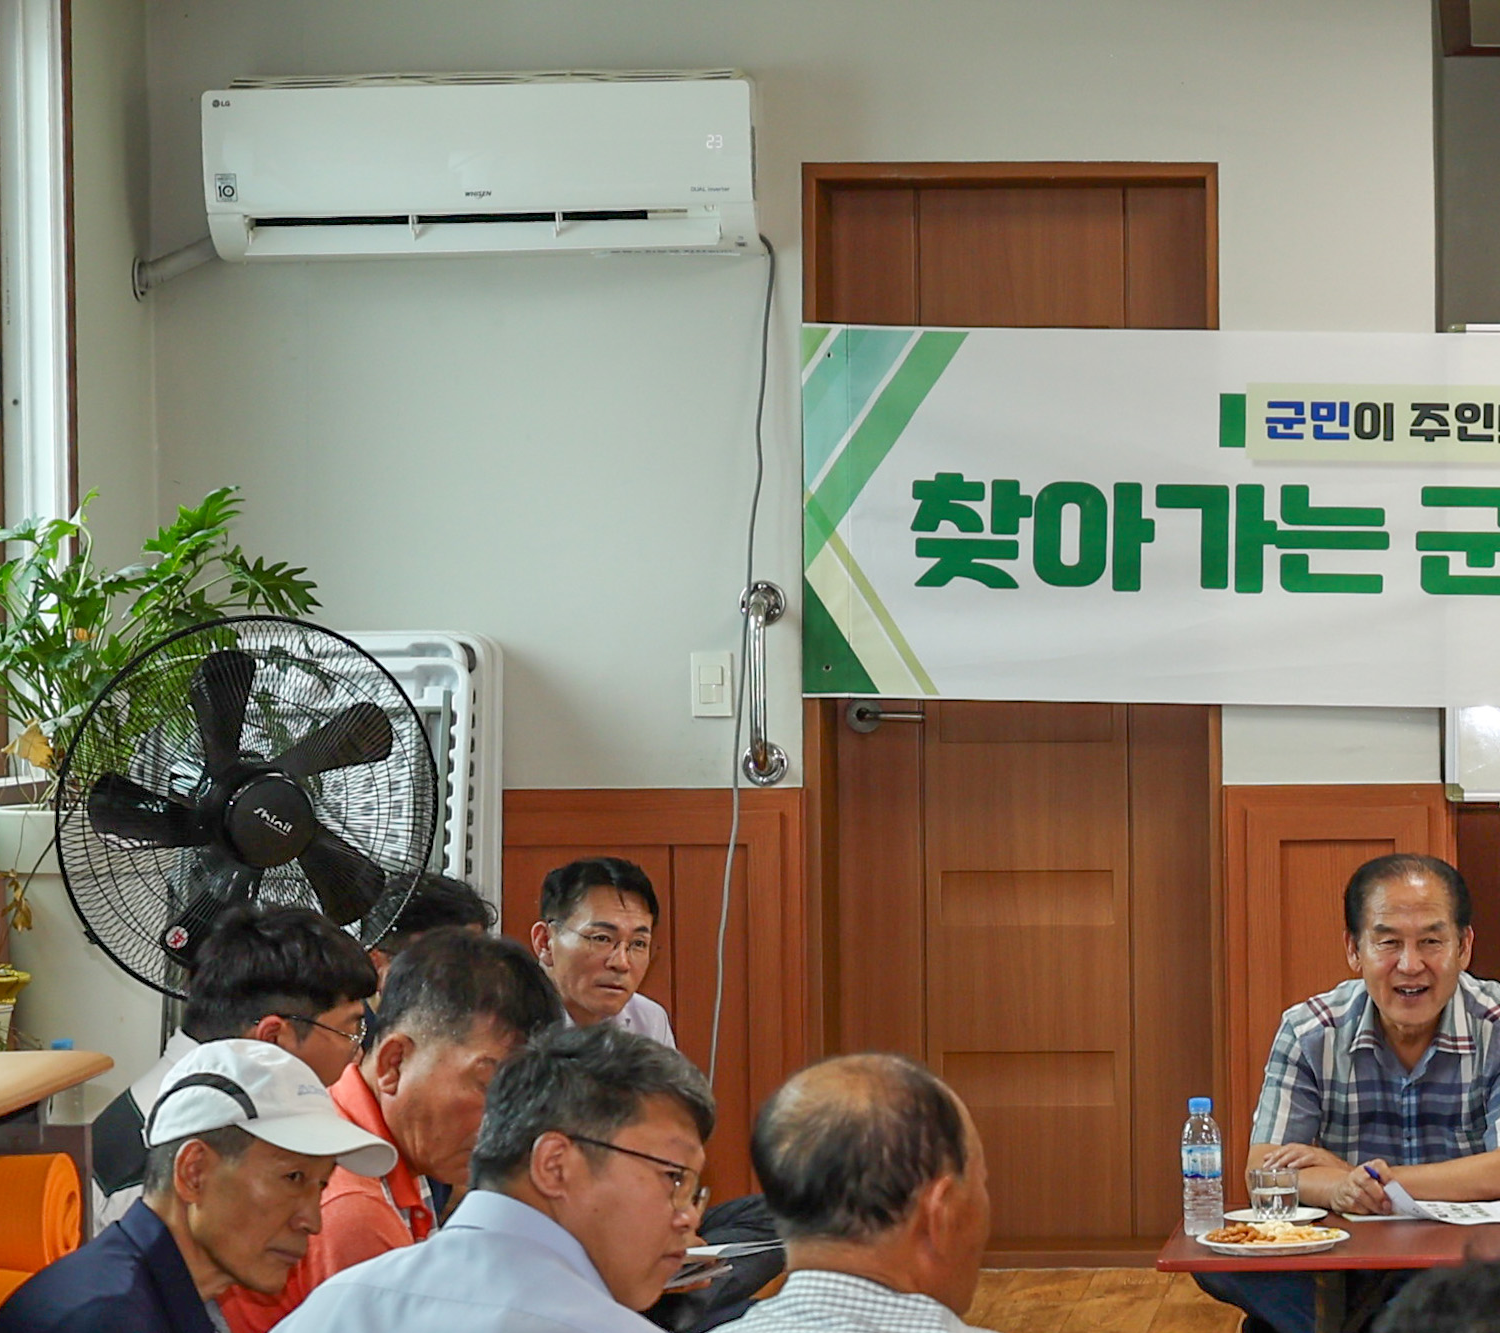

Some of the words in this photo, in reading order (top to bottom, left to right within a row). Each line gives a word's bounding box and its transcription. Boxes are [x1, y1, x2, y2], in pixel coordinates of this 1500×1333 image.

[706, 134, 724, 149] 23
[1265, 400, 1394, 442] 군민이
[910, 472, 1390, 594] 찾아가는
